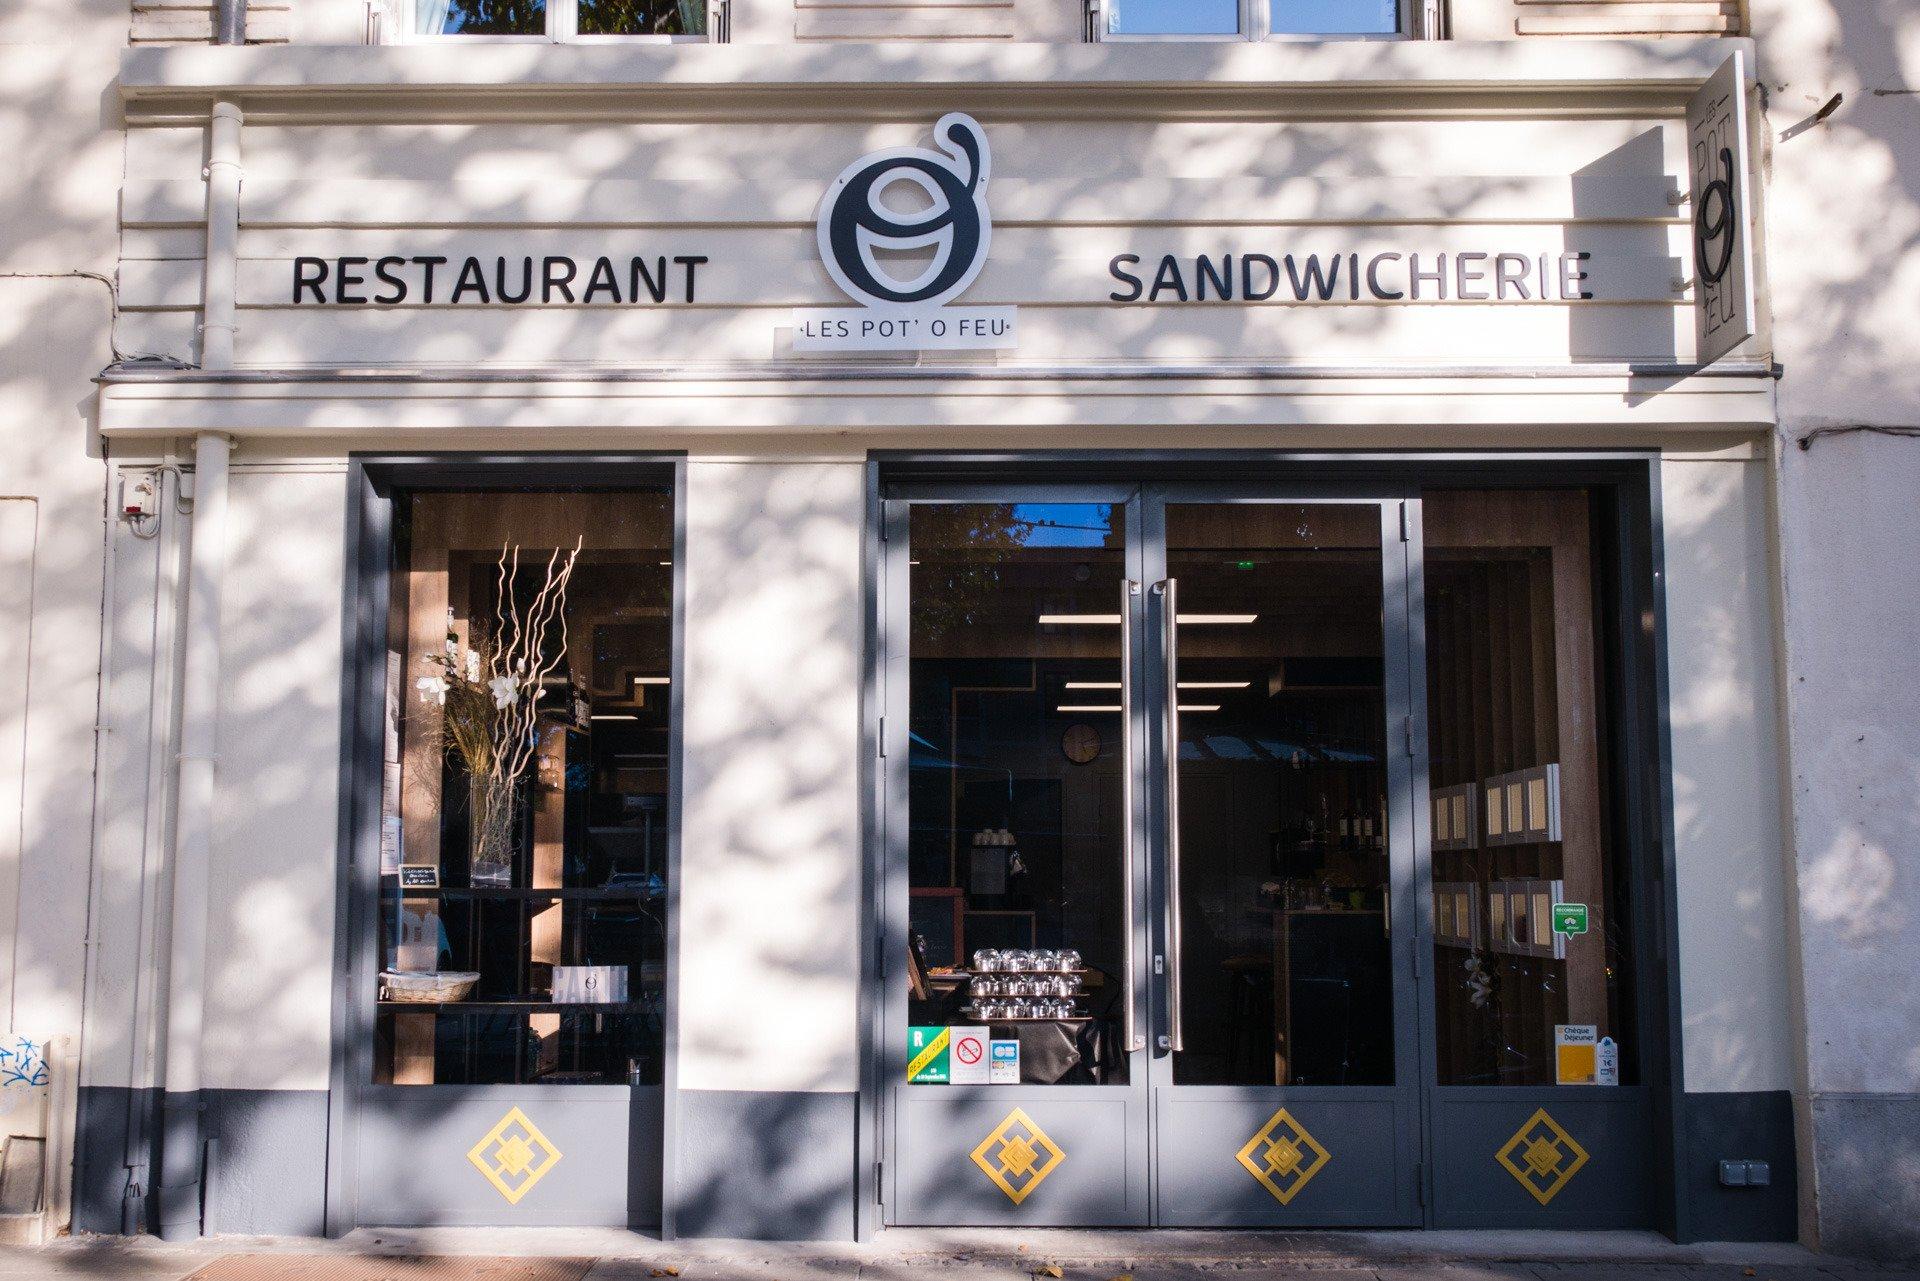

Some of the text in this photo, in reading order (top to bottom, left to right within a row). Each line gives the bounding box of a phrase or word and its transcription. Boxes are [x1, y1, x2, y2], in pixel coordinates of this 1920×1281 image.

[292, 256, 709, 304] RESTAURANT
[1109, 252, 1594, 301] SANDWICHERIE
[805, 319, 849, 338] LES
[931, 319, 947, 337] O
[958, 318, 1005, 337] FEU
[913, 1030, 924, 1047] R
